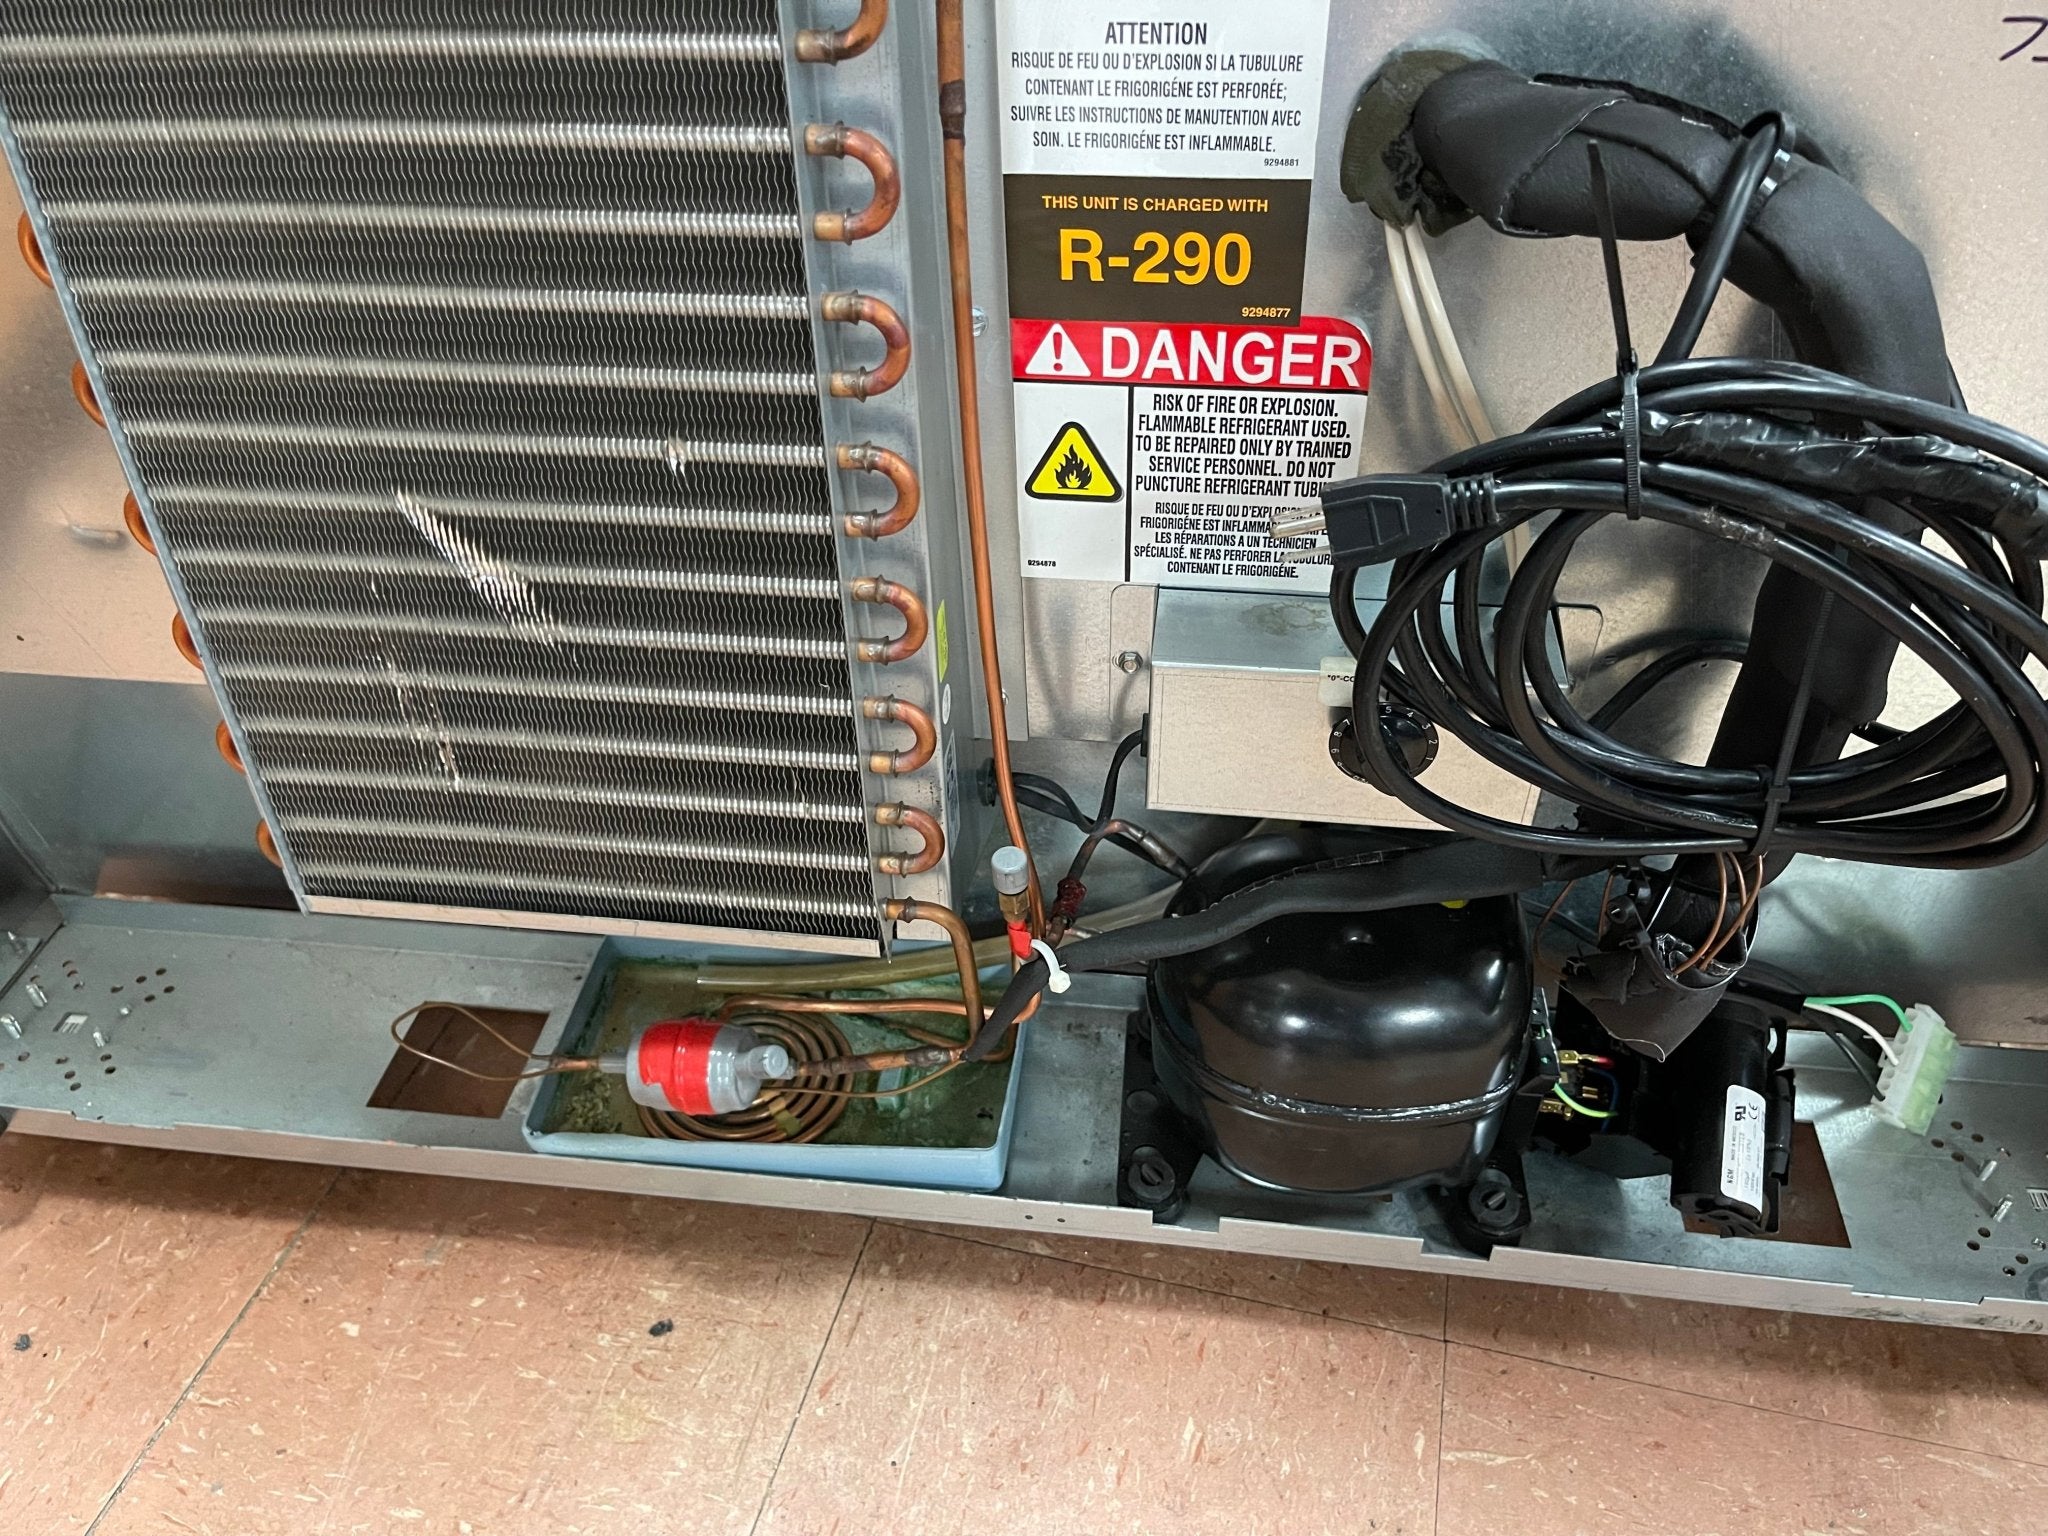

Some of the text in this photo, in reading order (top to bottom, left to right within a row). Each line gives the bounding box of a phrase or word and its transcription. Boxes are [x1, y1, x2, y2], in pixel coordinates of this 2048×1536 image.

[1105, 22, 1207, 45] ATTENTION
[1011, 52, 1303, 72] RISQUE DE FEU OU D'EXPLOSION SI LA TUBULURE
[1025, 77, 1287, 102] CONTENANT LE FRIGORIGÉNE EST PERFORÉE;
[1011, 105, 1301, 126] SUIVRE LES INSTRUCTIONS DE MANUTENTION AVEC
[1033, 129, 1275, 152] SOIN. LE FRIGORIGÉNE EST INFLAMMABLE.
[1264, 158, 1299, 166] 9294881
[1042, 195, 1268, 212] THIS UNIT IS CHARGED WITH
[1060, 229, 1251, 285] R-290
[1242, 307, 1291, 318] 9294877
[1102, 326, 1361, 387] DANGER
[1153, 393, 1338, 417] RISK OF FIRE OR EXPLOSION.
[1139, 414, 1350, 438] FLAMMABLE REFRIGERANT USED.
[1135, 435, 1352, 459] TO BE REPAIRED ONLY BY TRAINED
[1149, 455, 1336, 478] SERVICE PERSONNEL. DO NOT
[1136, 475, 1201, 493] PUNCTURE
[1204, 478, 1291, 497] REFRIGERANT
[1155, 502, 1190, 515] RISQUE
[1192, 503, 1204, 516] DE
[1206, 504, 1224, 517] FEU
[1226, 504, 1240, 517] OU
[1140, 515, 1201, 530] FRIGORIGÉNE
[1203, 519, 1221, 531] EST
[1155, 531, 1317, 550] LES RÉPARATIONS A UN TECHNICIEN
[1134, 543, 1187, 559] SPÉCIALISÉ.
[1190, 547, 1202, 560] NE
[1204, 548, 1221, 560] PAS
[1223, 549, 1272, 563] PERFORER
[1167, 561, 1221, 575] CONTENANT
[1222, 563, 1234, 575] LE
[1385, 706, 1392, 714] 5
